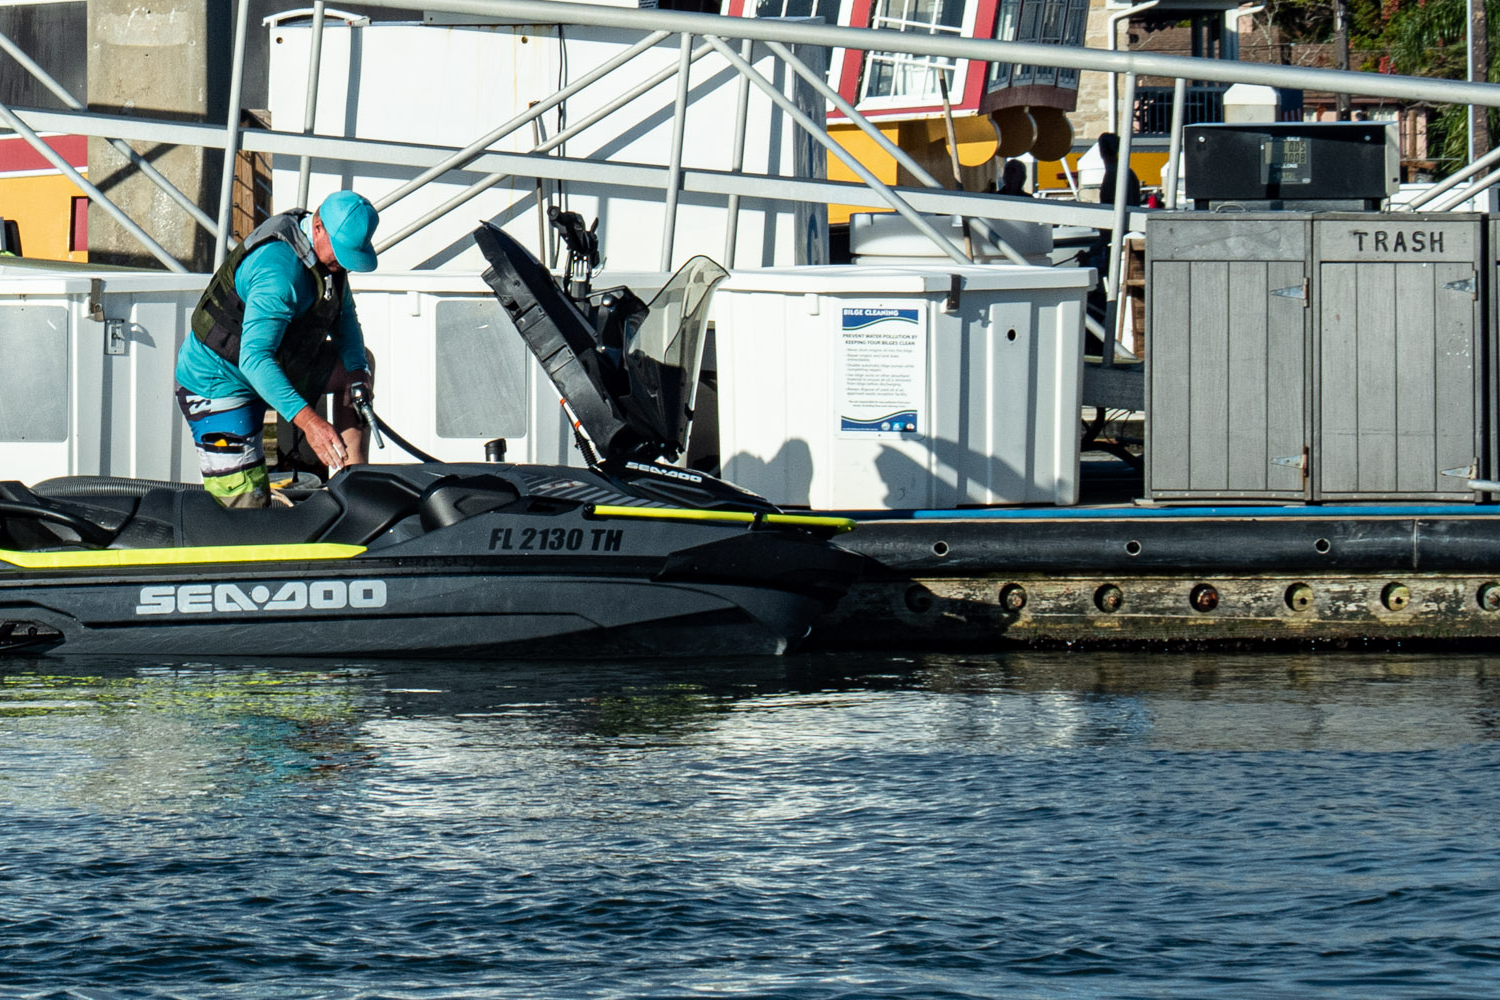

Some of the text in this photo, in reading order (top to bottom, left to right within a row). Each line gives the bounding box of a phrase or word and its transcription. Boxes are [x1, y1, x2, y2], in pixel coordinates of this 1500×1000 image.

[1352, 230, 1444, 253] TRASH
[843, 308, 900, 317] BILGE CLEANING
[488, 527, 624, 552] FL 2130 TH
